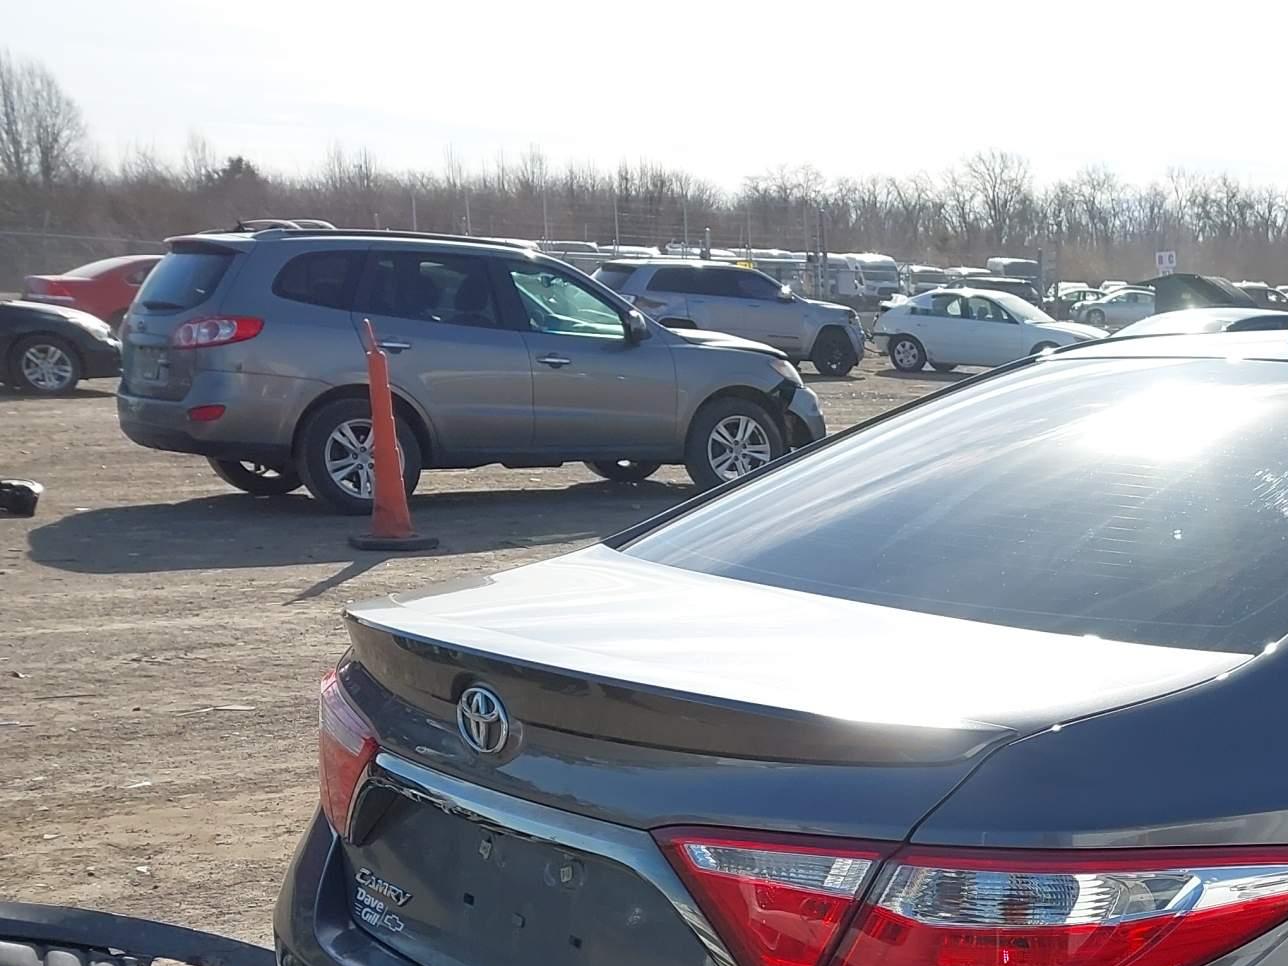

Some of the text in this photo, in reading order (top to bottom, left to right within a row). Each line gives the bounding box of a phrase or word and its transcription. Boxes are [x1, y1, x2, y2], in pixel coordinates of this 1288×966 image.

[355, 867, 412, 906] CAMRY
[356, 887, 385, 912] Dave
[361, 907, 380, 926] Gill
